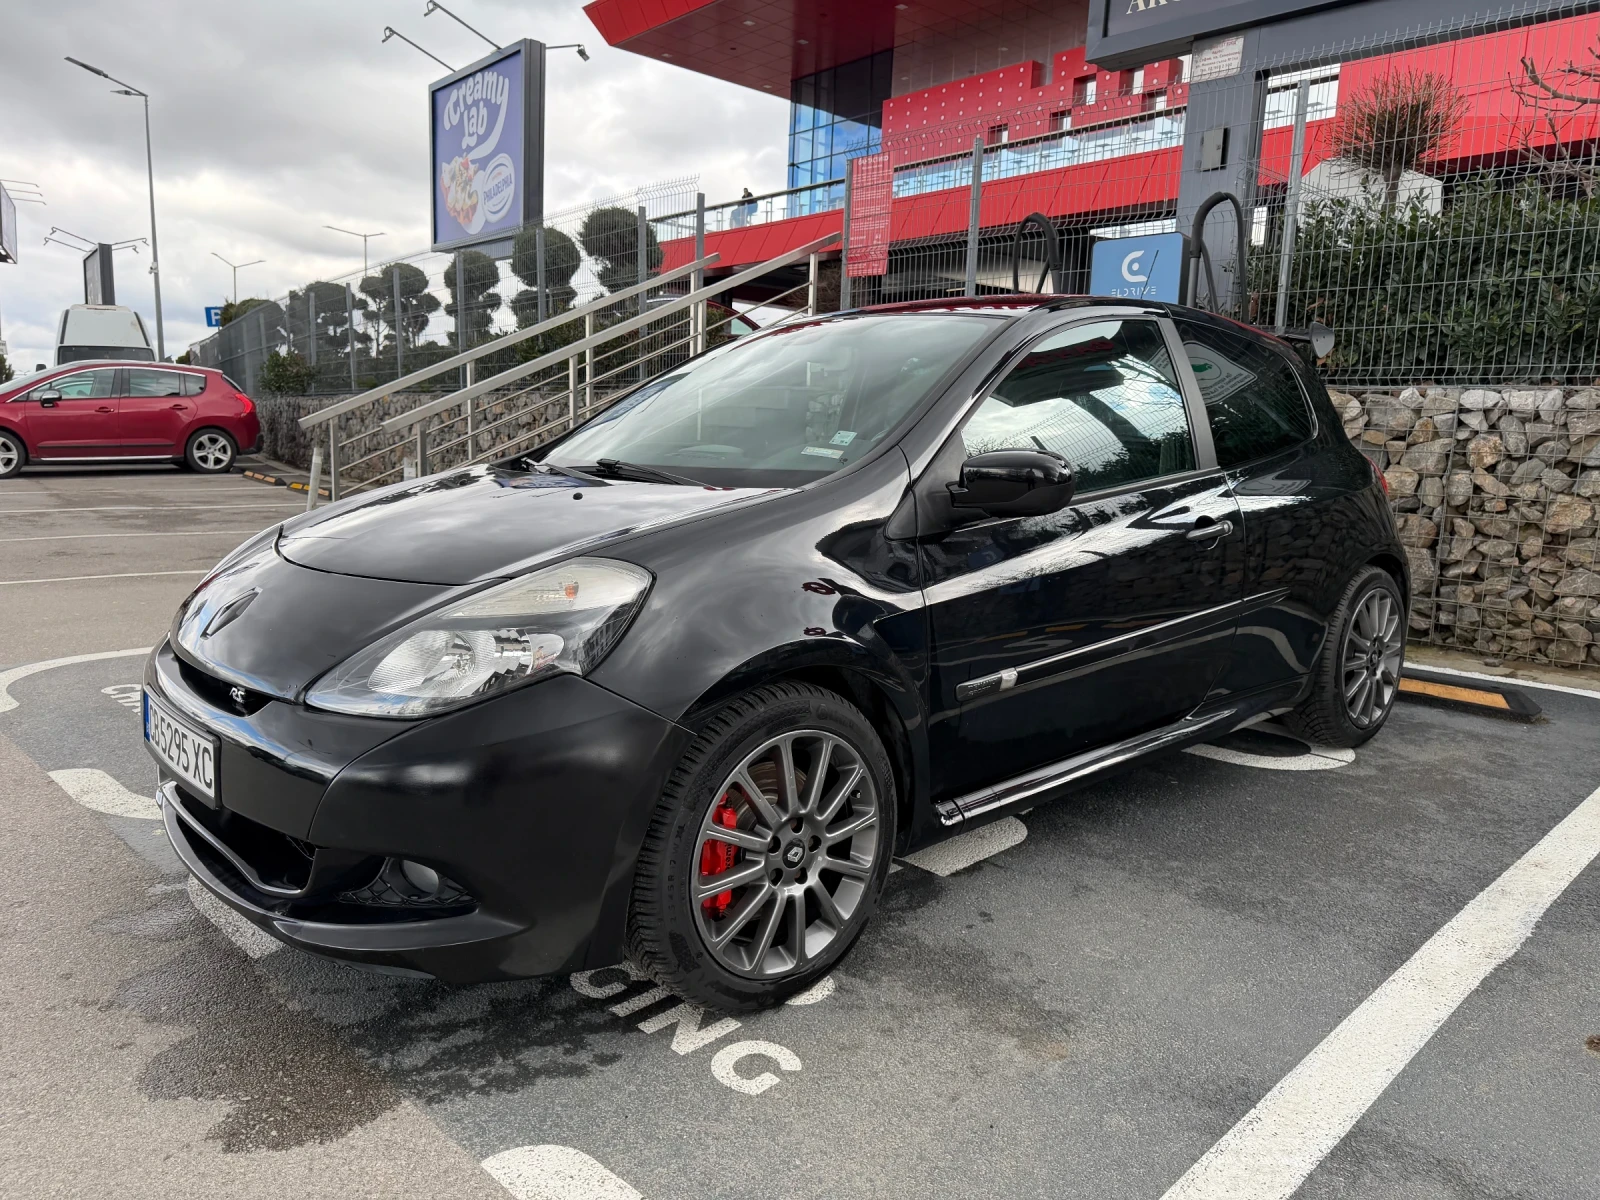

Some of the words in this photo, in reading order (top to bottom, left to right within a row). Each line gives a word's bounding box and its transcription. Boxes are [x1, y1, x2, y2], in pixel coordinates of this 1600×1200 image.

[443, 71, 509, 157] Creamy
[462, 101, 487, 149] Lab
[483, 173, 513, 206] PHILADELPHIA
[1111, 286, 1157, 298] ELDRIVE
[210, 309, 221, 325] P
